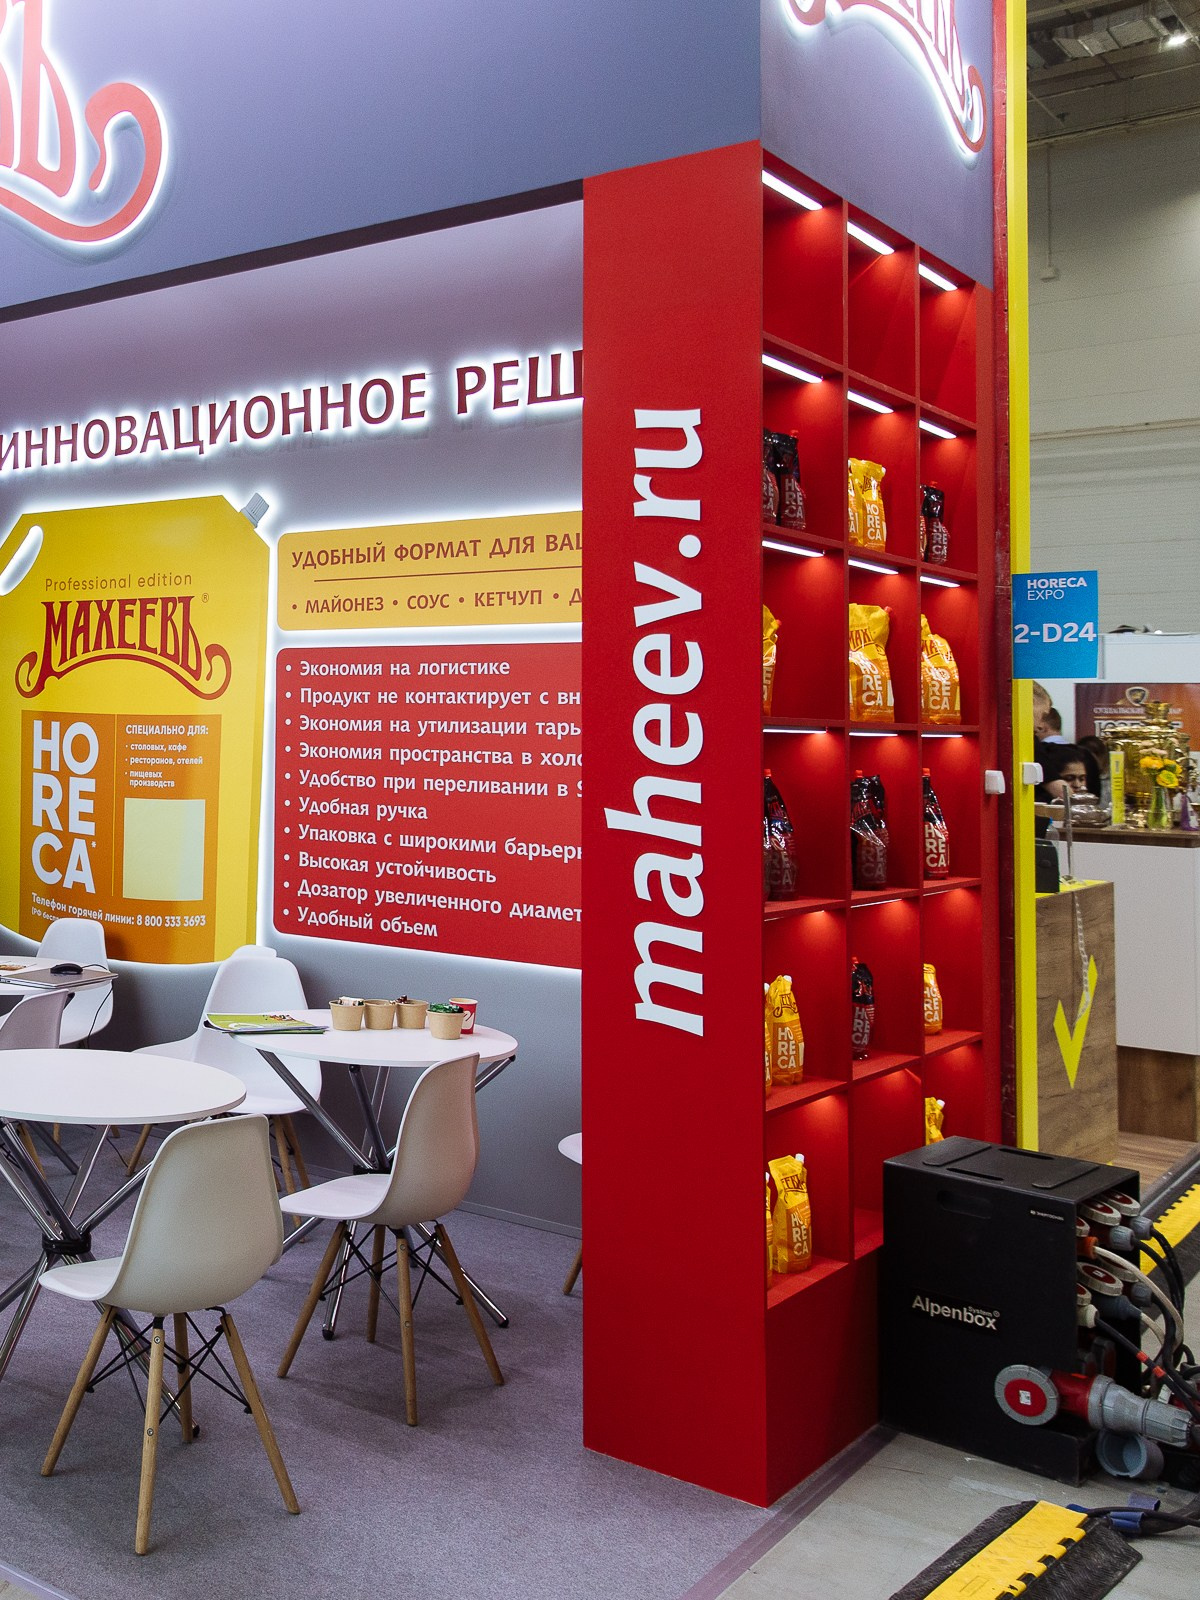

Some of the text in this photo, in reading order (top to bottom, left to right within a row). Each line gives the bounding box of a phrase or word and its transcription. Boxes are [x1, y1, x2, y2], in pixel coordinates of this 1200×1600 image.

[865, 502, 879, 516] HO
[866, 515, 880, 529] RE
[867, 528, 882, 541] CA
[291, 541, 386, 570] УДОБНЫЙ
[393, 539, 482, 562] ФОРМАТ
[488, 535, 535, 558] ДЛЯ
[45, 572, 192, 592] Professional edition
[1027, 577, 1088, 589] HORECA
[305, 594, 385, 614] МАЙОНЕЗ
[406, 593, 450, 610] СОУС
[474, 589, 543, 608] КЕТЧУП
[1027, 589, 1065, 601] EXPO
[1014, 621, 1097, 644] 2-D24
[299, 660, 511, 676] Экономия на логистике
[862, 674, 883, 691] RE
[929, 680, 951, 697] RE
[299, 687, 371, 708] Продукт
[377, 690, 398, 704] не
[405, 690, 532, 709] контактирует
[539, 691, 549, 705] с
[862, 691, 883, 707] CA
[929, 695, 951, 711] CA
[125, 724, 209, 737] СПЕЦИАЛЬНО ДЛЯ:
[299, 715, 382, 732] Экономия
[390, 718, 410, 733] на
[417, 719, 527, 737] утилизации
[603, 407, 705, 1038] maheev.ru
[32, 719, 100, 776] HO
[130, 742, 187, 753] столовых, кафе
[299, 742, 382, 760] Экономия
[389, 746, 513, 766] пространства
[521, 751, 532, 765] в
[129, 756, 203, 766] ресторанов, отелей
[129, 770, 163, 779] пищевых
[299, 769, 568, 796] Удобство при переливании в
[129, 779, 175, 788] производств
[32, 771, 97, 836] RE
[298, 796, 428, 821] Удобная ручка
[298, 824, 377, 845] Упаковка
[383, 833, 392, 846] с
[399, 833, 496, 853] широкими
[925, 838, 947, 854] RE
[298, 851, 497, 883] Высокая устойчивость
[925, 853, 947, 868] CA
[297, 878, 368, 903] Дозатор
[375, 888, 502, 914] увеличенного
[31, 891, 206, 928] Телефон горячей линии: 8 800 333 3693
[297, 906, 438, 937] Удобный объем
[777, 1041, 796, 1057] RE
[777, 1055, 797, 1070] CA
[911, 1294, 998, 1331] Alpenbox
